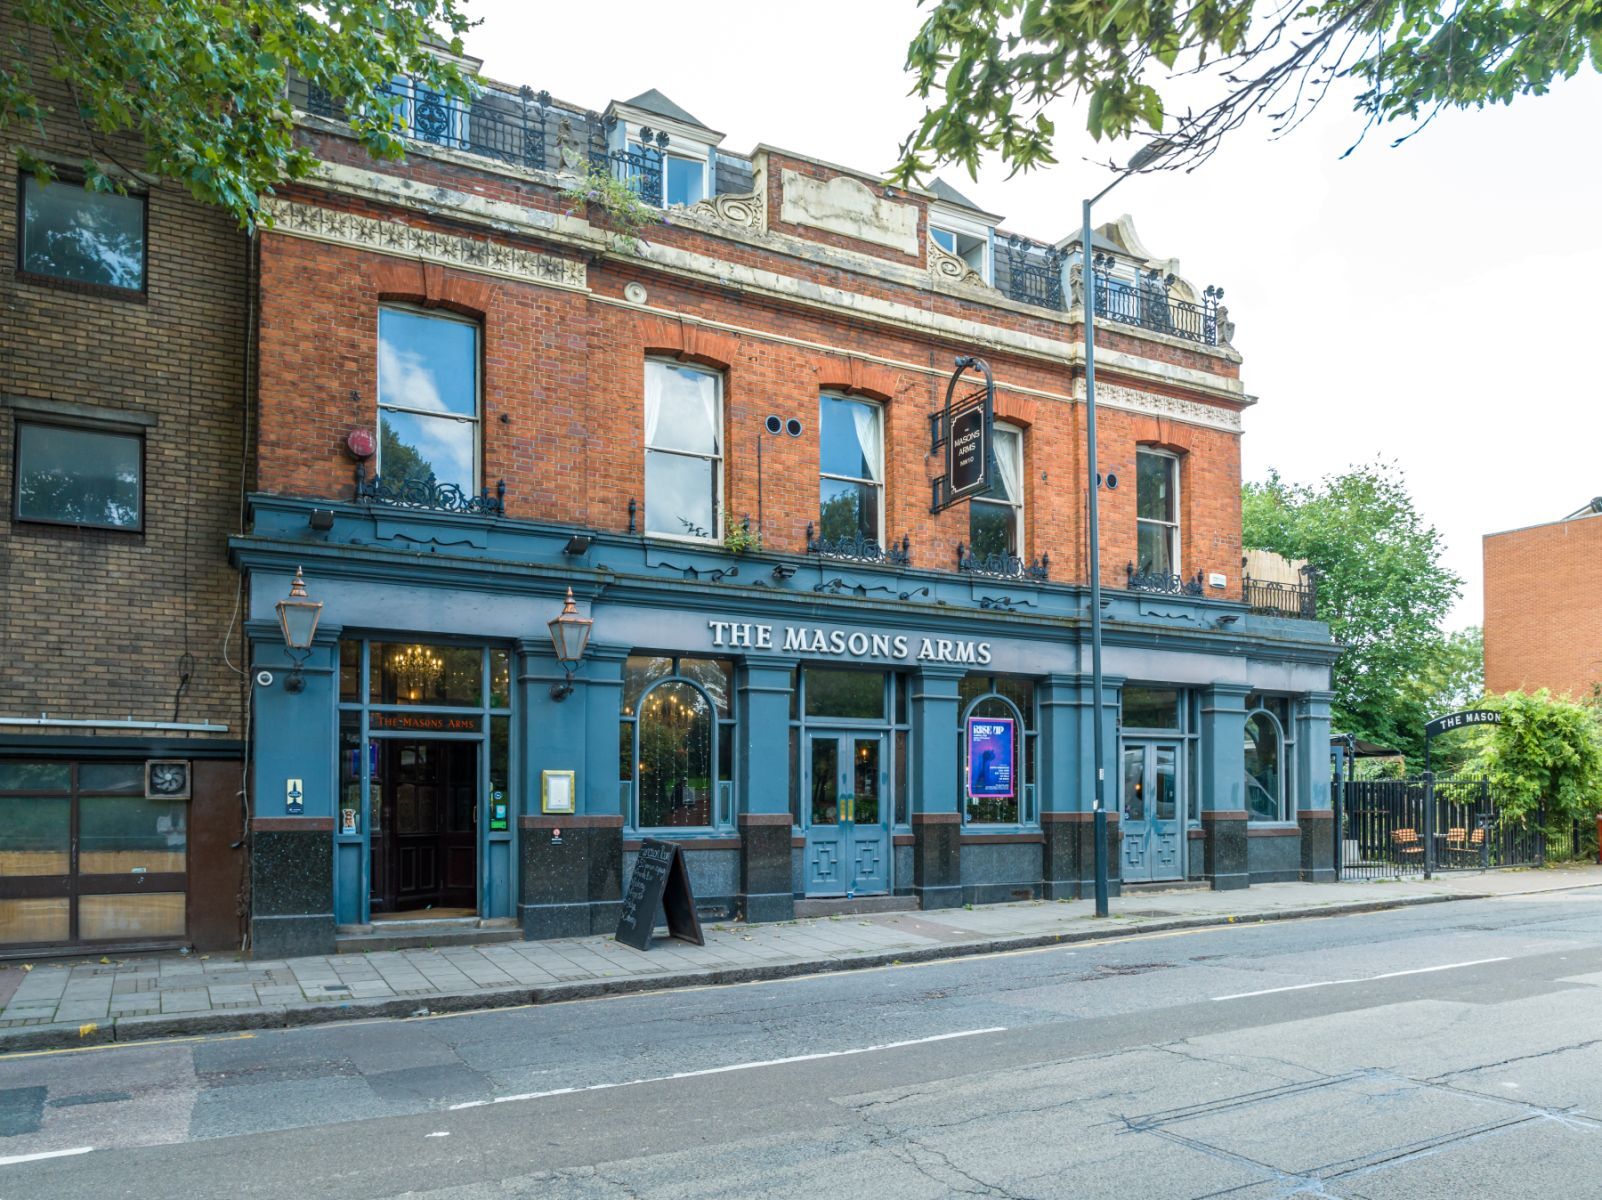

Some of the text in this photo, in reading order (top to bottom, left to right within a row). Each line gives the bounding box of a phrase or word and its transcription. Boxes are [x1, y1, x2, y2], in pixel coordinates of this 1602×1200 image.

[954, 430, 980, 447] MASONS
[958, 442, 976, 456] ARMS
[708, 620, 992, 665] THE MASONS ARMS
[403, 717, 442, 728] MASONS
[448, 719, 474, 728] ARMS
[1440, 715, 1462, 729] THE
[973, 725, 1005, 735] RISE UP
